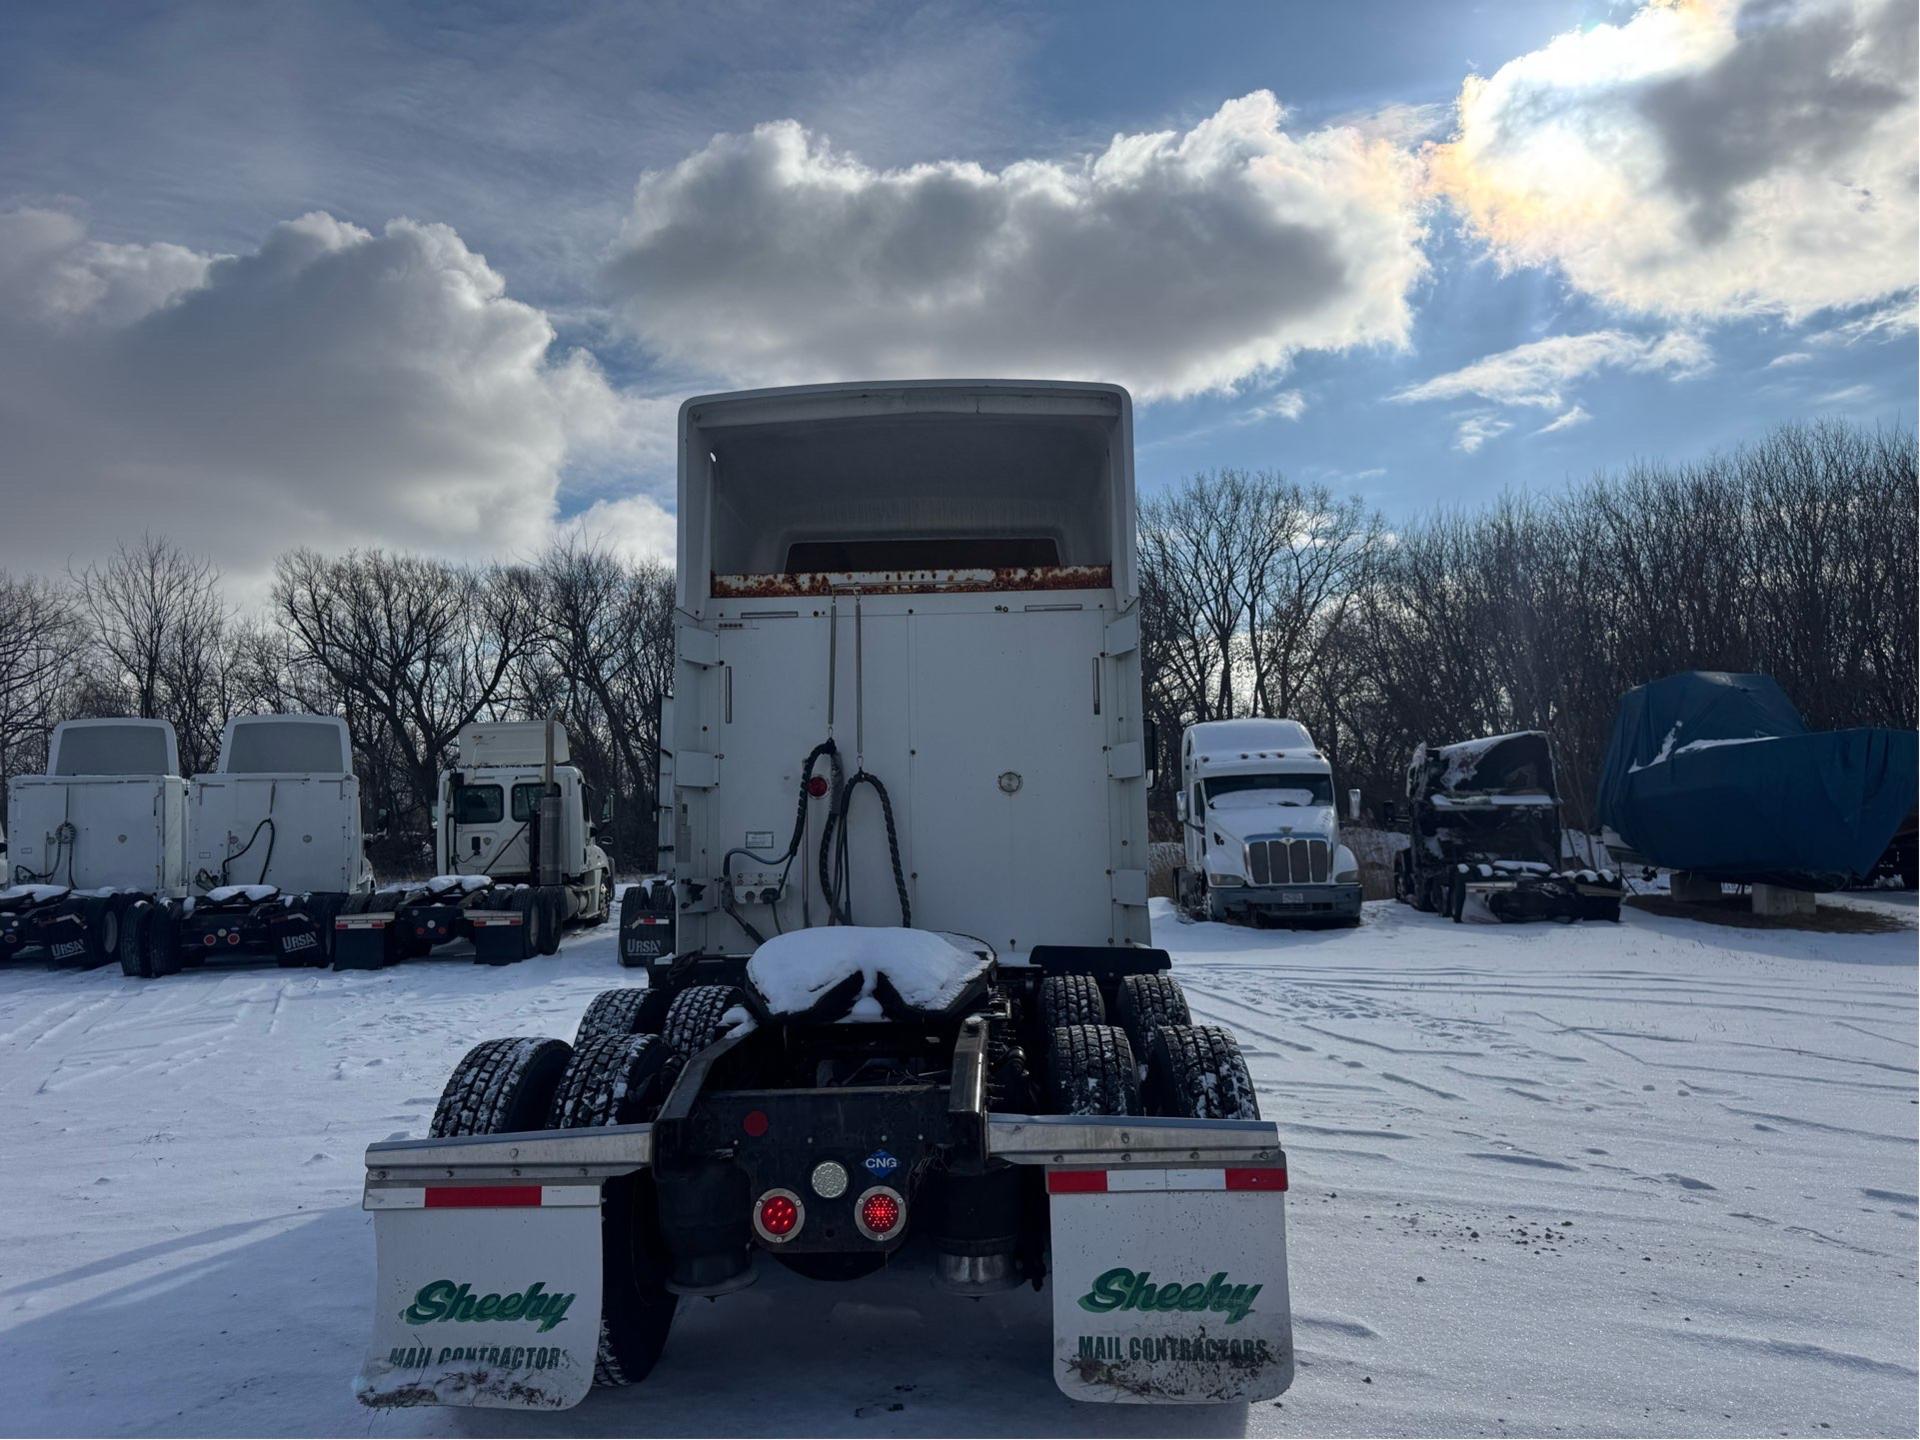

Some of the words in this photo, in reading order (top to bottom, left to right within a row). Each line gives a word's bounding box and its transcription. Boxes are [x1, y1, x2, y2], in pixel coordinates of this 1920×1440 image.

[865, 1157, 897, 1169] CNG
[405, 1279, 576, 1333] Sheehy
[1078, 1267, 1264, 1325] Sheehy
[1078, 1336, 1123, 1360] MAIL
[1129, 1337, 1269, 1362] CONTRACTORS
